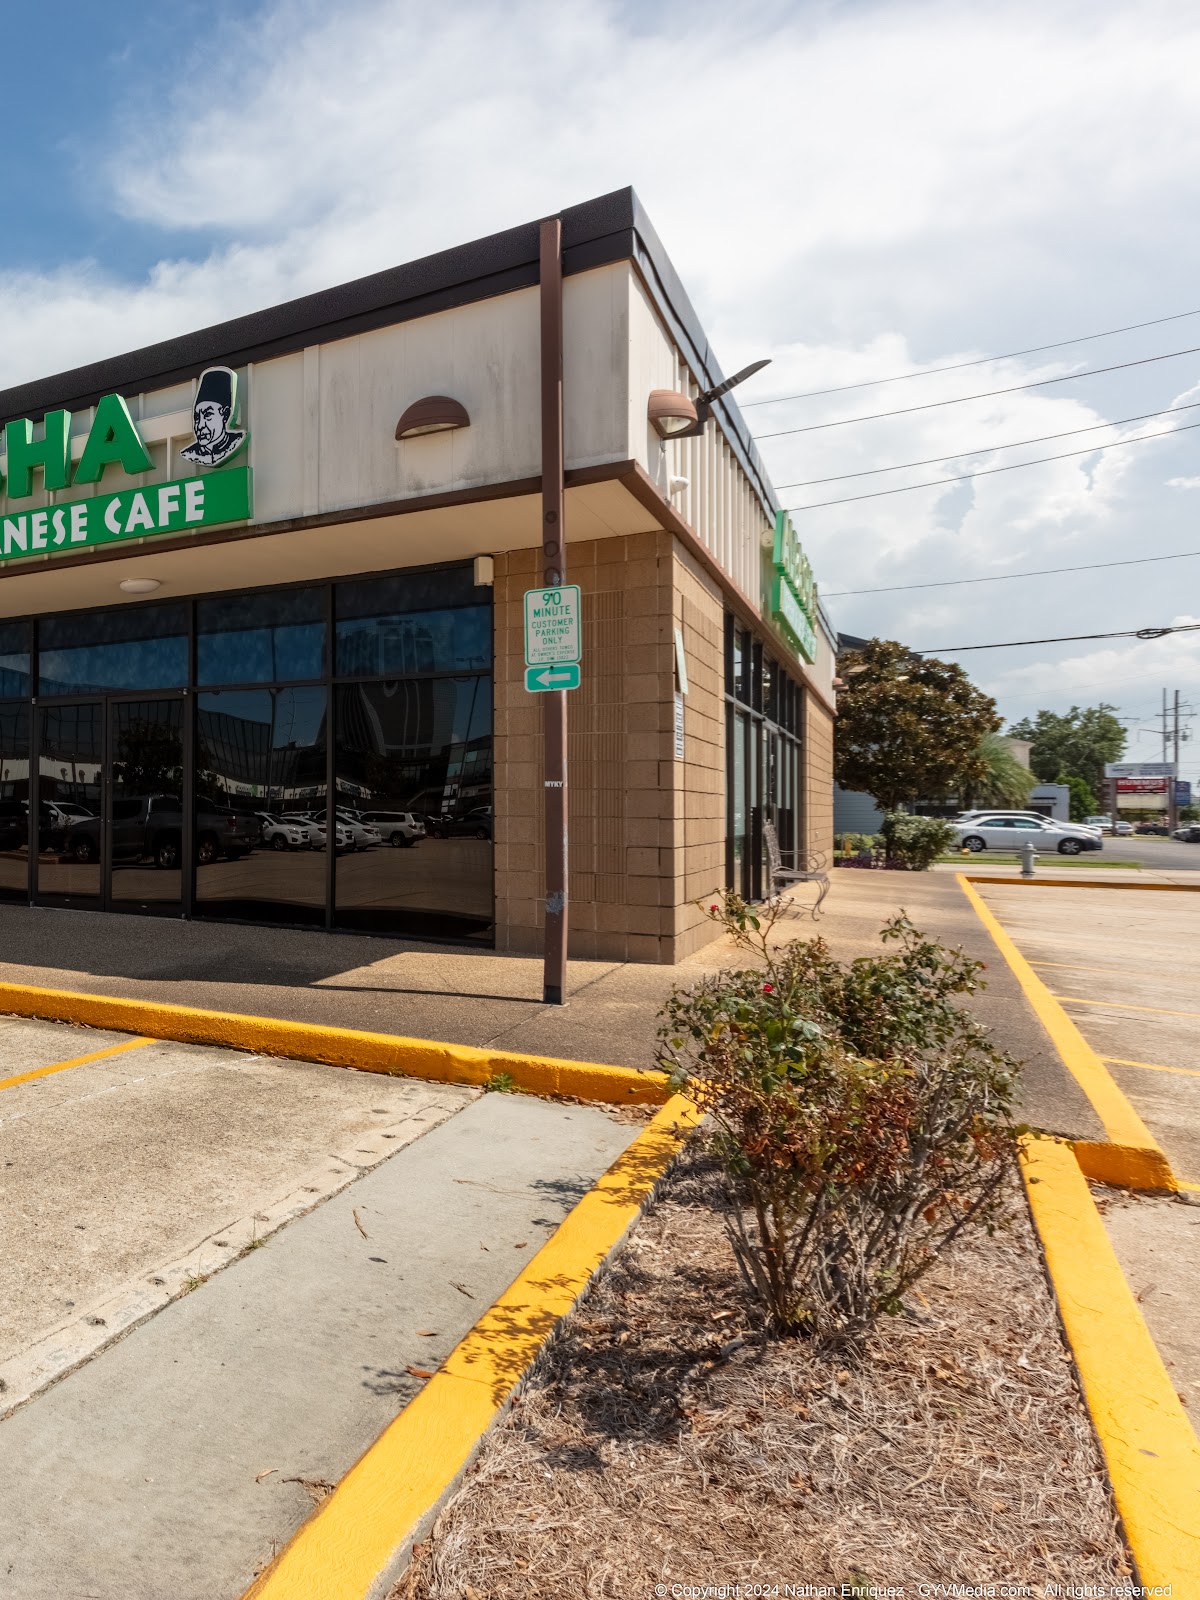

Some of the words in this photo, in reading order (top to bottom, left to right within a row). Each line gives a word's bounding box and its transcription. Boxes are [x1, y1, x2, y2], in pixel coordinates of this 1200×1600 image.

[104, 480, 205, 533] CAFE
[543, 592, 561, 606] 90
[534, 605, 571, 618] MINUTE
[532, 618, 573, 629] CUSTOMER
[536, 627, 569, 637] PARKING
[543, 637, 562, 645] ONLY
